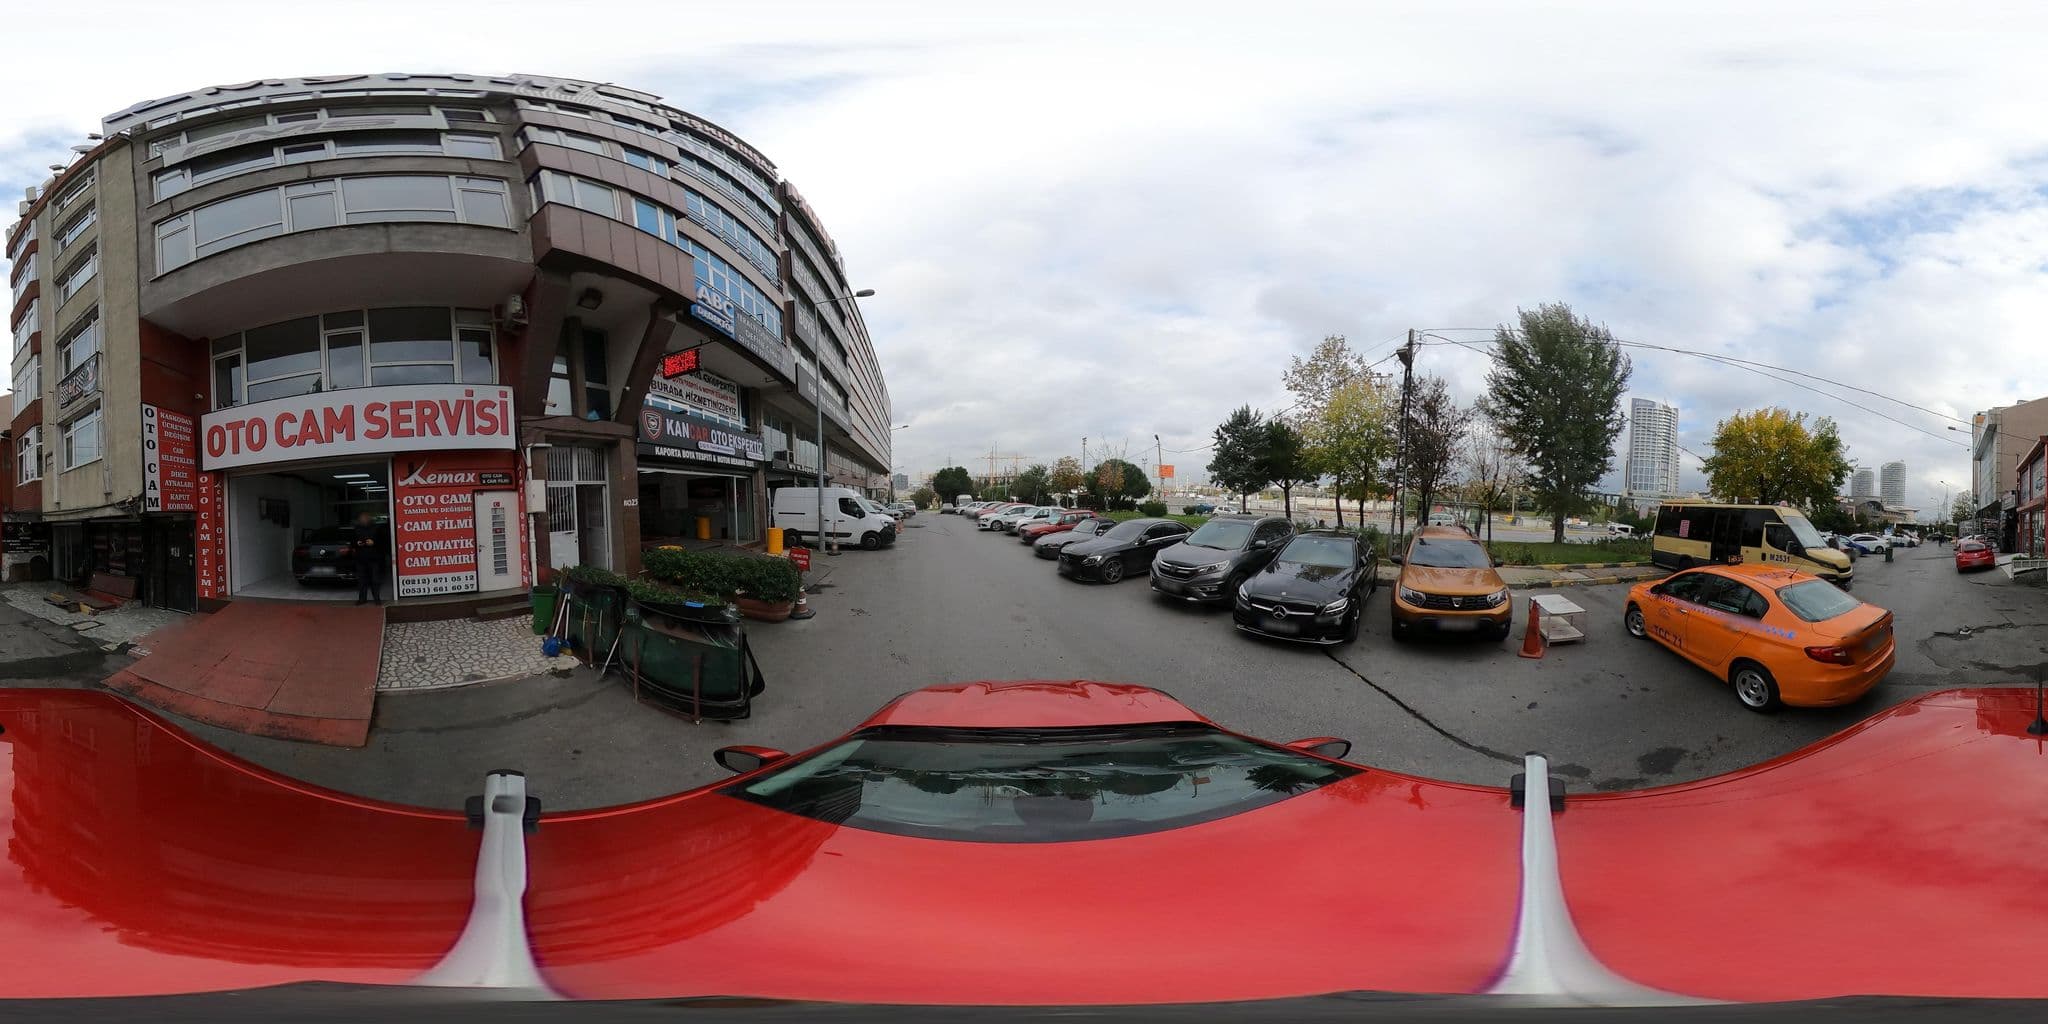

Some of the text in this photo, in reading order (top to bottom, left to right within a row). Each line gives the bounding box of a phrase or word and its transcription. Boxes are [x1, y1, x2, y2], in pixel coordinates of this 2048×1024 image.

[697, 287, 734, 319] ABC
[650, 380, 737, 416] BURADA HİZMETİNİZDEYİZ
[145, 407, 156, 450] OTO
[162, 421, 192, 433] ÜCRETSİZ
[206, 389, 510, 457] OTO CAM SERVİSİ
[710, 429, 728, 447] OTO
[728, 433, 763, 454] EKSPERTİZ
[172, 447, 184, 455] CAM
[655, 446, 681, 458] KAPORTA
[398, 458, 476, 486] Kemax
[147, 463, 160, 508] CAM
[164, 480, 194, 488] AYNALARI
[170, 493, 190, 501] KAPUT
[402, 494, 473, 506] OTO CAM
[404, 507, 428, 515] TAMİRİ
[440, 505, 472, 513] DEĞİŞİMİ
[404, 516, 473, 532] CAM FİLMİ
[200, 476, 212, 597] OTO CAM FİLMİ
[404, 536, 475, 552] OTOMATİK
[405, 551, 476, 568] CAM TAMİRİ
[217, 565, 225, 594] CAM
[401, 577, 431, 586] (0212)
[433, 576, 448, 584] 671
[401, 587, 431, 595] (0531)
[465, 582, 475, 590] 57
